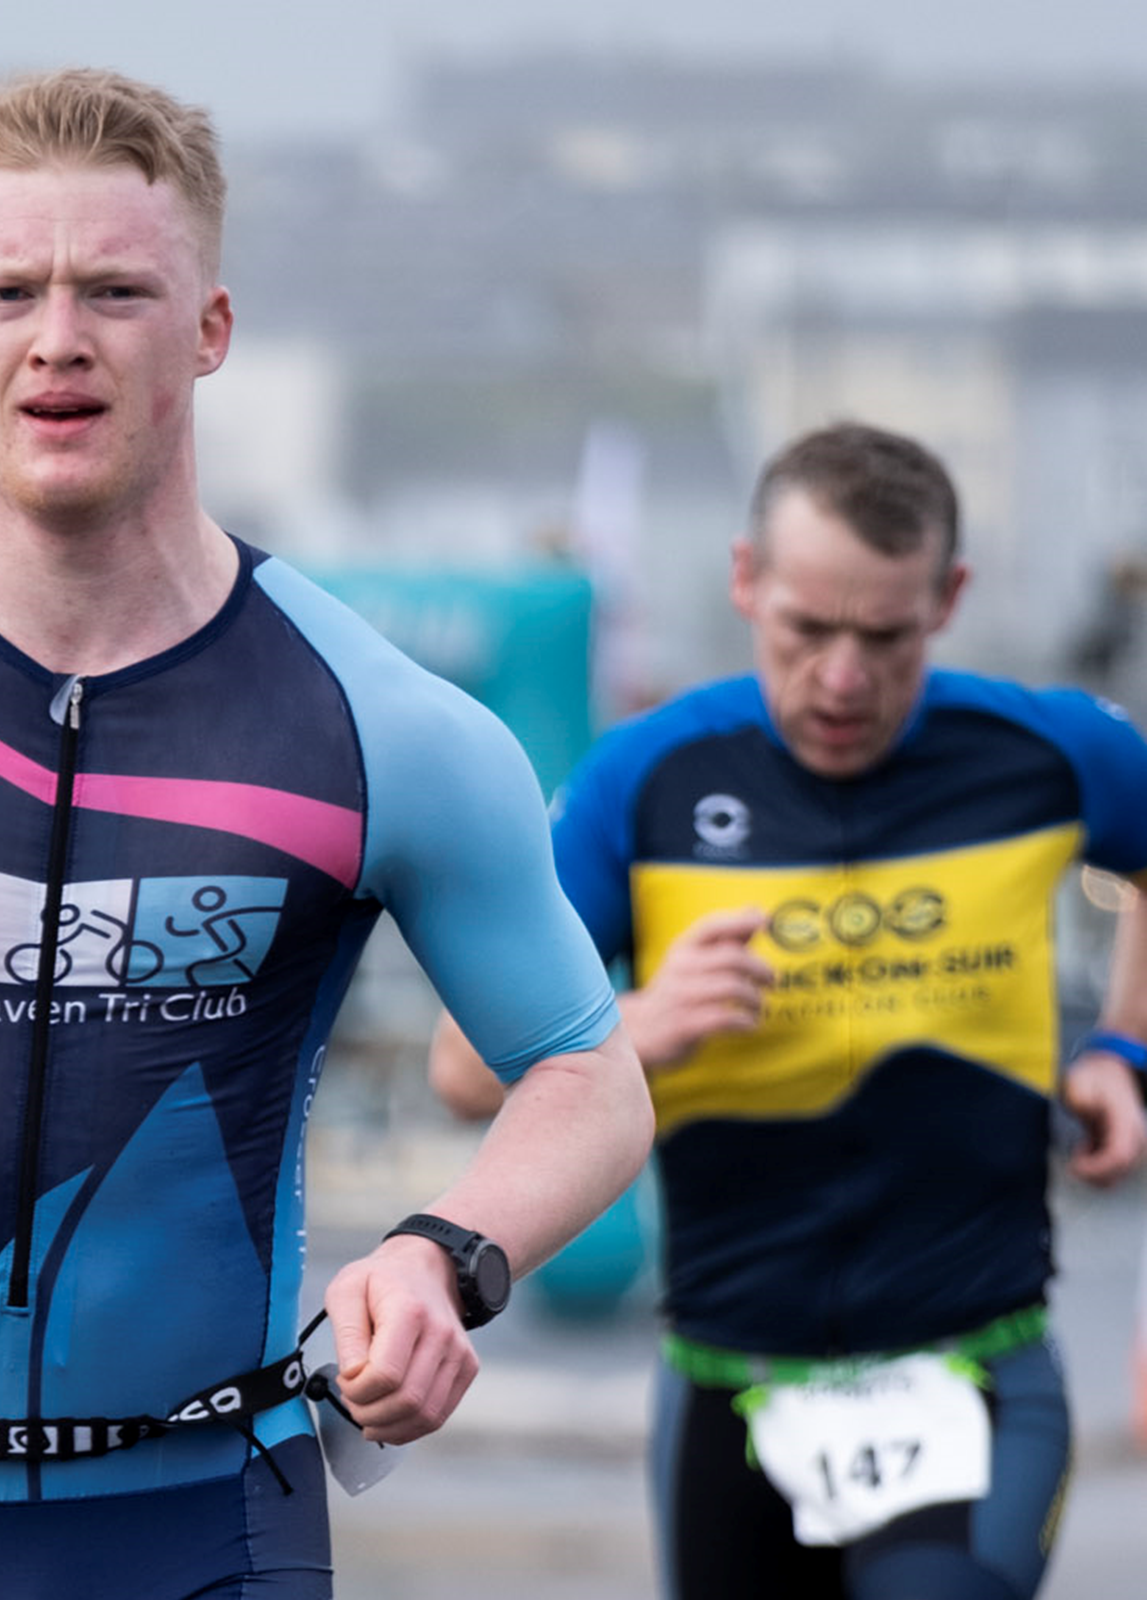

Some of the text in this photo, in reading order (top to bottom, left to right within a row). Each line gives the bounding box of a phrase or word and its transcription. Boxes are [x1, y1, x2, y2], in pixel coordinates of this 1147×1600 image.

[98, 992, 152, 1022] Tri
[160, 986, 248, 1022] Club
[815, 1438, 923, 1500] 147
